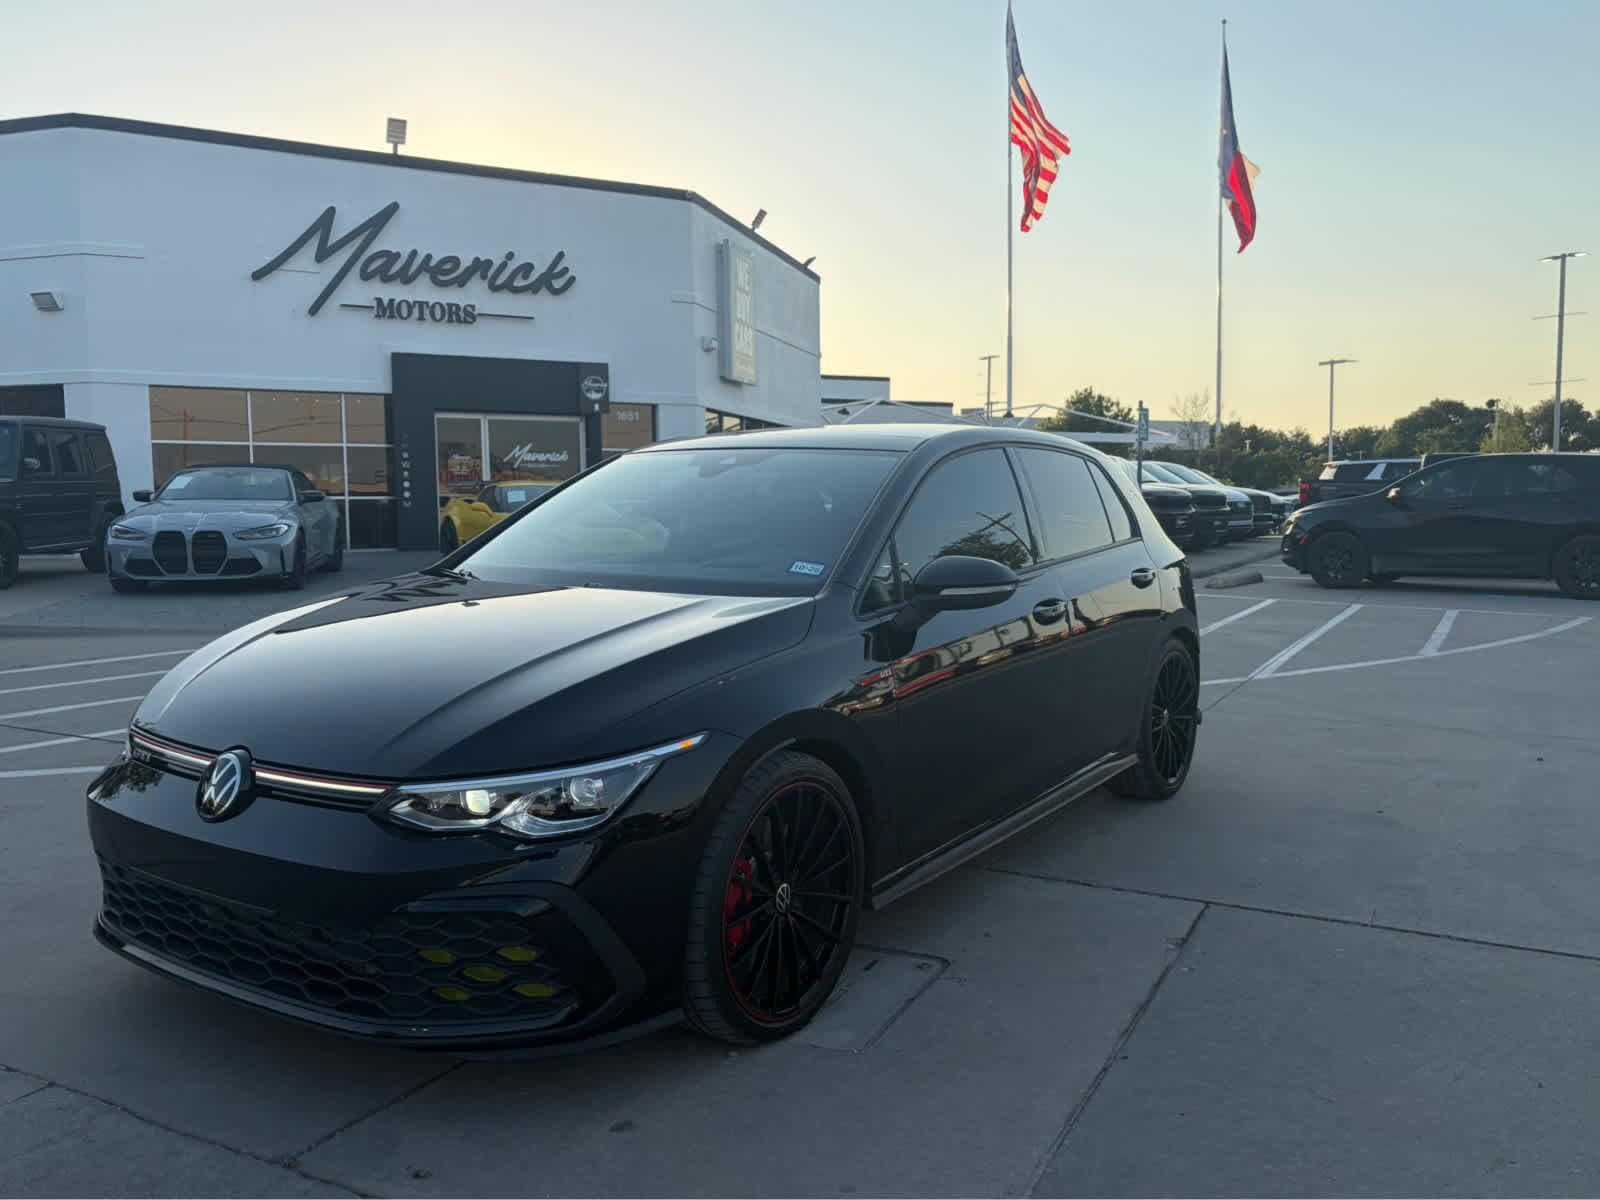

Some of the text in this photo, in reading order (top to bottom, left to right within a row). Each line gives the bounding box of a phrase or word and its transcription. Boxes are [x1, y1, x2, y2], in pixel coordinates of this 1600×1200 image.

[251, 201, 577, 316] Maverick
[373, 297, 477, 324] MOTORS
[503, 442, 568, 468] Maverick
